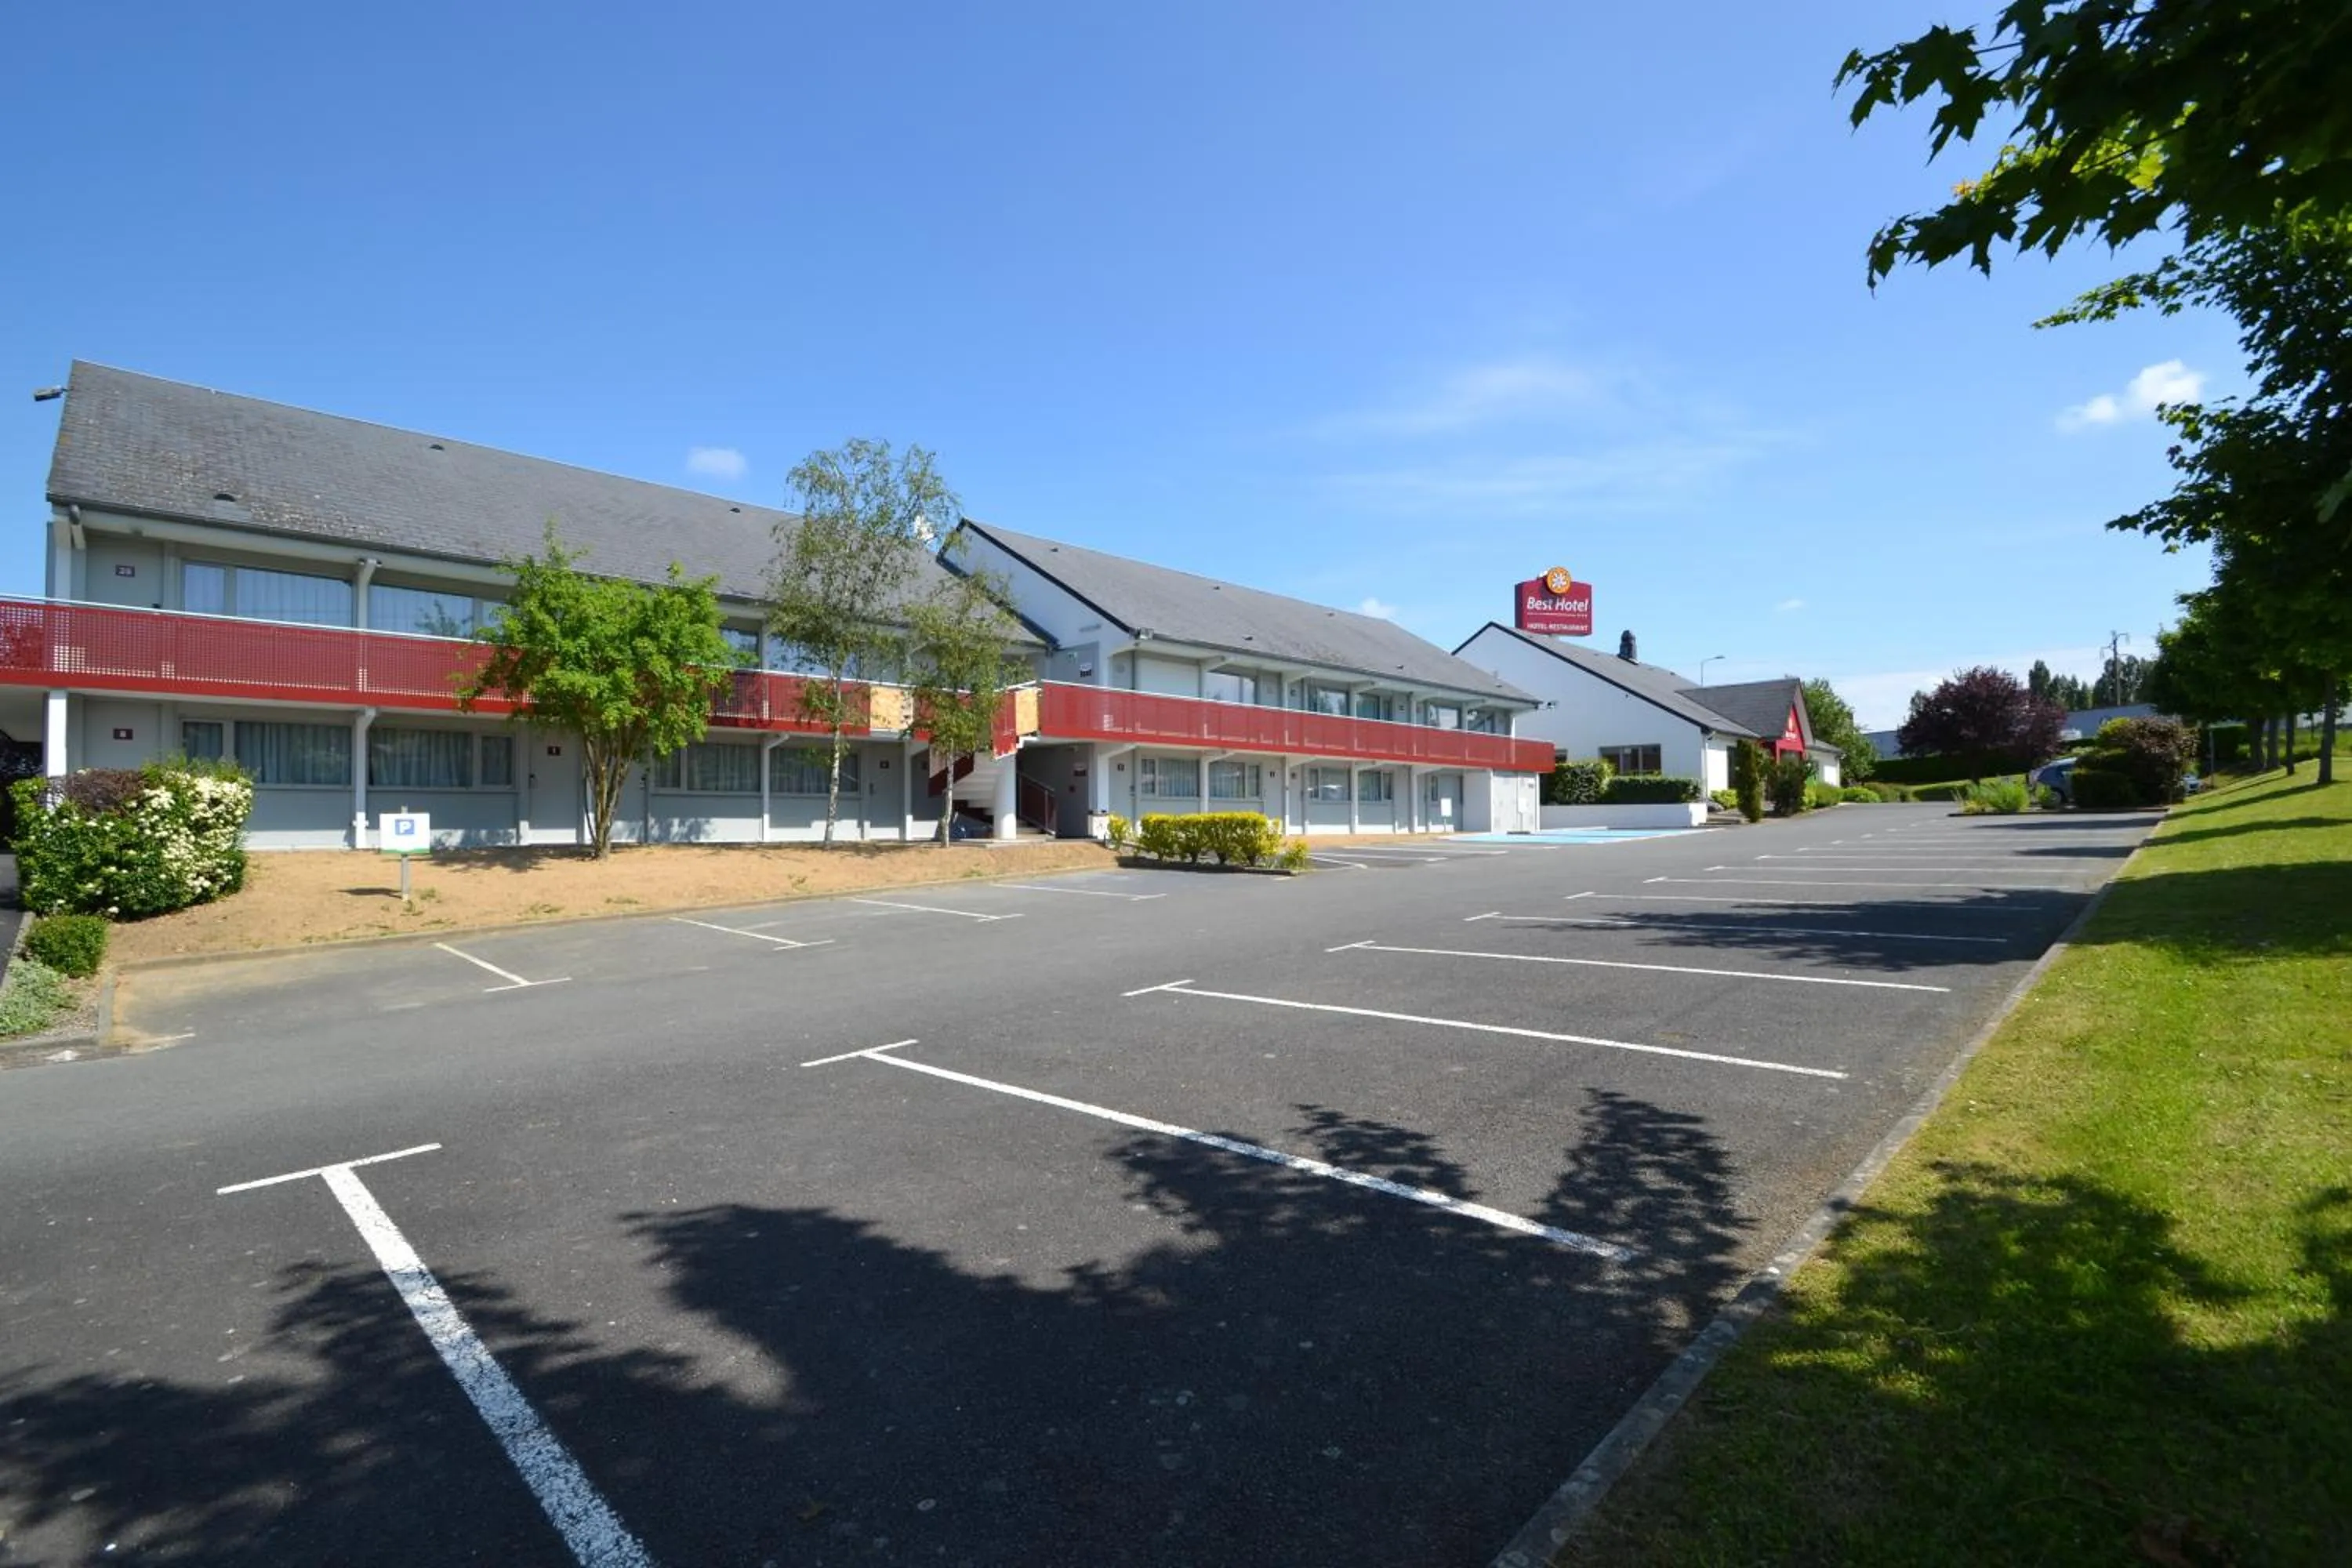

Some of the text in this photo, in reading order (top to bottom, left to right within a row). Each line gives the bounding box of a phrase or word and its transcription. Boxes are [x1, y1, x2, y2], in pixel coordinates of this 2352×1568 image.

[1526, 596, 1589, 612] Best Hotel
[1548, 623, 1588, 632] RESTAURANT
[399, 821, 412, 833] P
